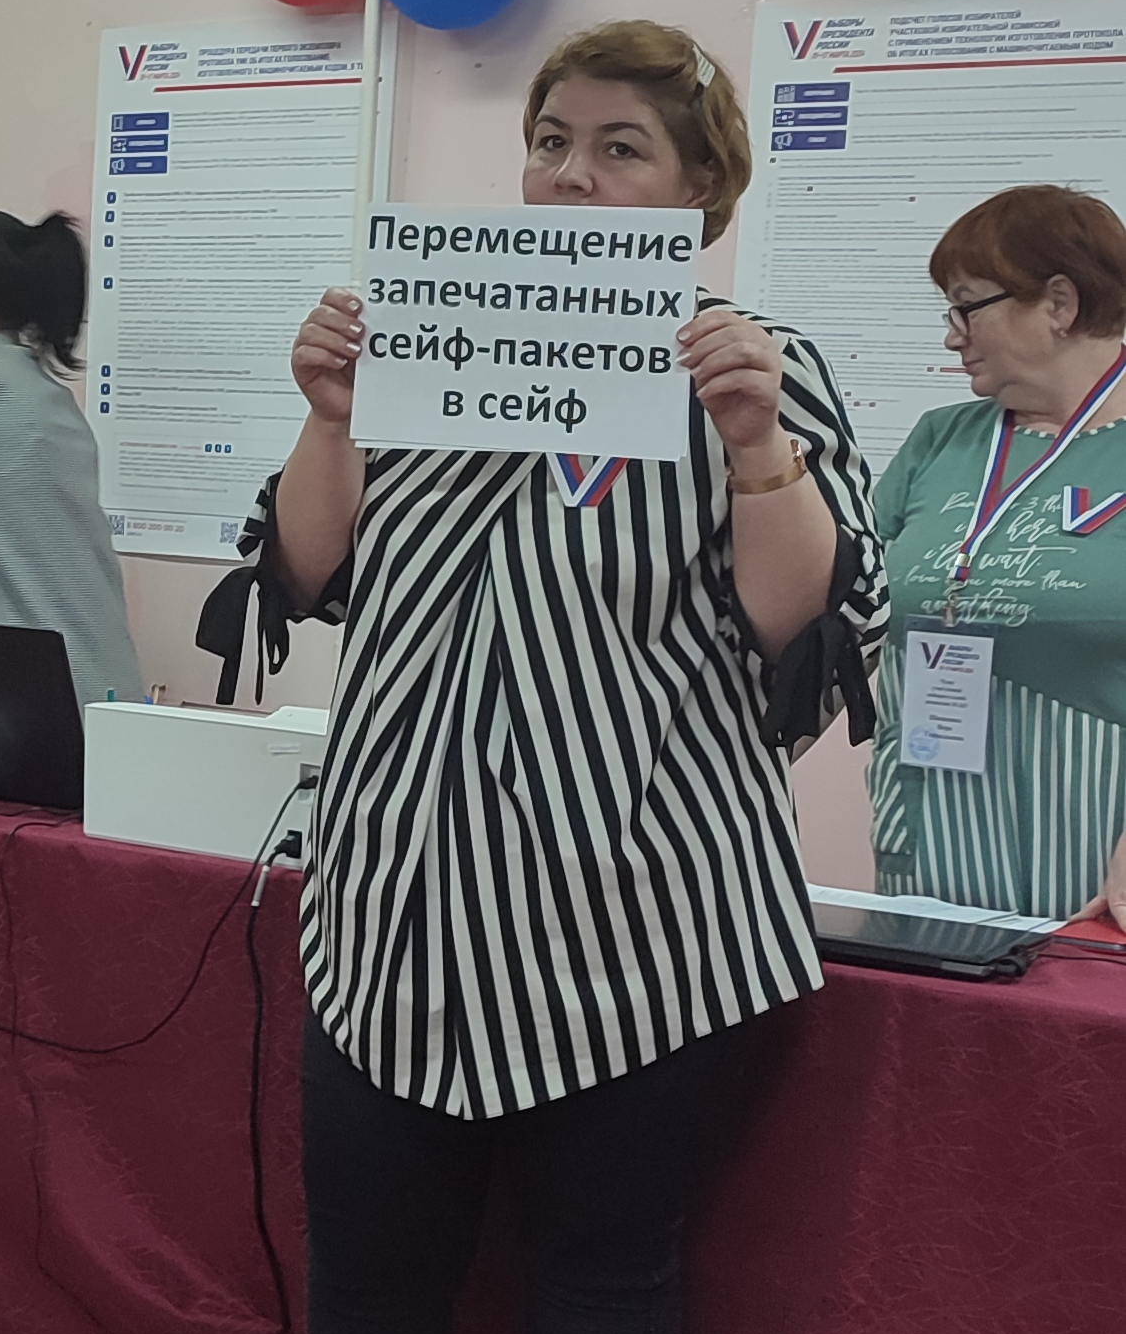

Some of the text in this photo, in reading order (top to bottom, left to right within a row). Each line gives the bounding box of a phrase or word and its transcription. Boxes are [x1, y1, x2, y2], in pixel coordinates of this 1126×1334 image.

[368, 215, 693, 265] Перемещение
[367, 277, 683, 318] запечатанных
[368, 323, 672, 374] сейф-пакетов
[442, 384, 587, 434] в сейф
[1041, 570, 1087, 591] than
